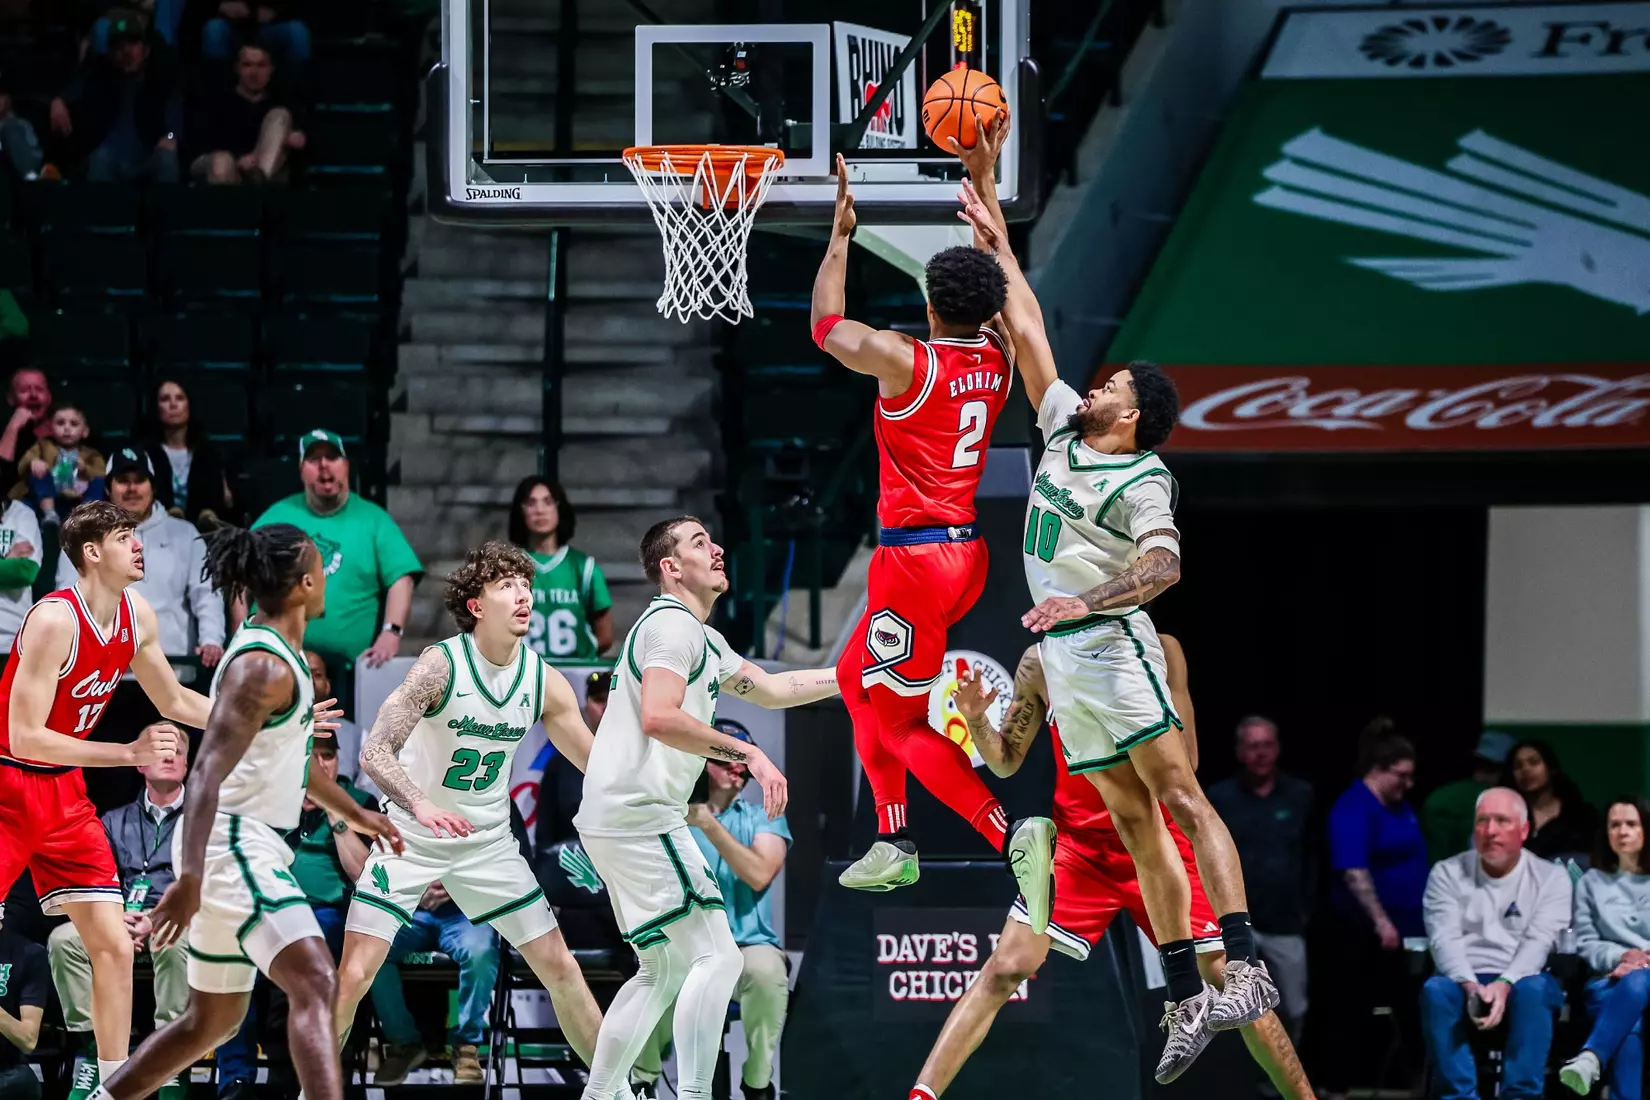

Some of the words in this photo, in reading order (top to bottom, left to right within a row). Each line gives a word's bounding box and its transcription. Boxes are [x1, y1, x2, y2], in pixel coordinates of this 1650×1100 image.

[1530, 21, 1650, 58] Fr
[465, 187, 521, 200] SPALDING
[949, 371, 1003, 398] ELOHIM
[951, 400, 988, 469] 2
[1025, 504, 1062, 563] 10
[549, 588, 579, 604] TEXA
[521, 608, 577, 656] 26
[73, 700, 107, 733] 17
[447, 715, 494, 733] Mean
[493, 722, 526, 741] Green
[442, 747, 506, 791] 23
[877, 932, 978, 964] DAVE'S
[889, 970, 1029, 1001] CHICKN
